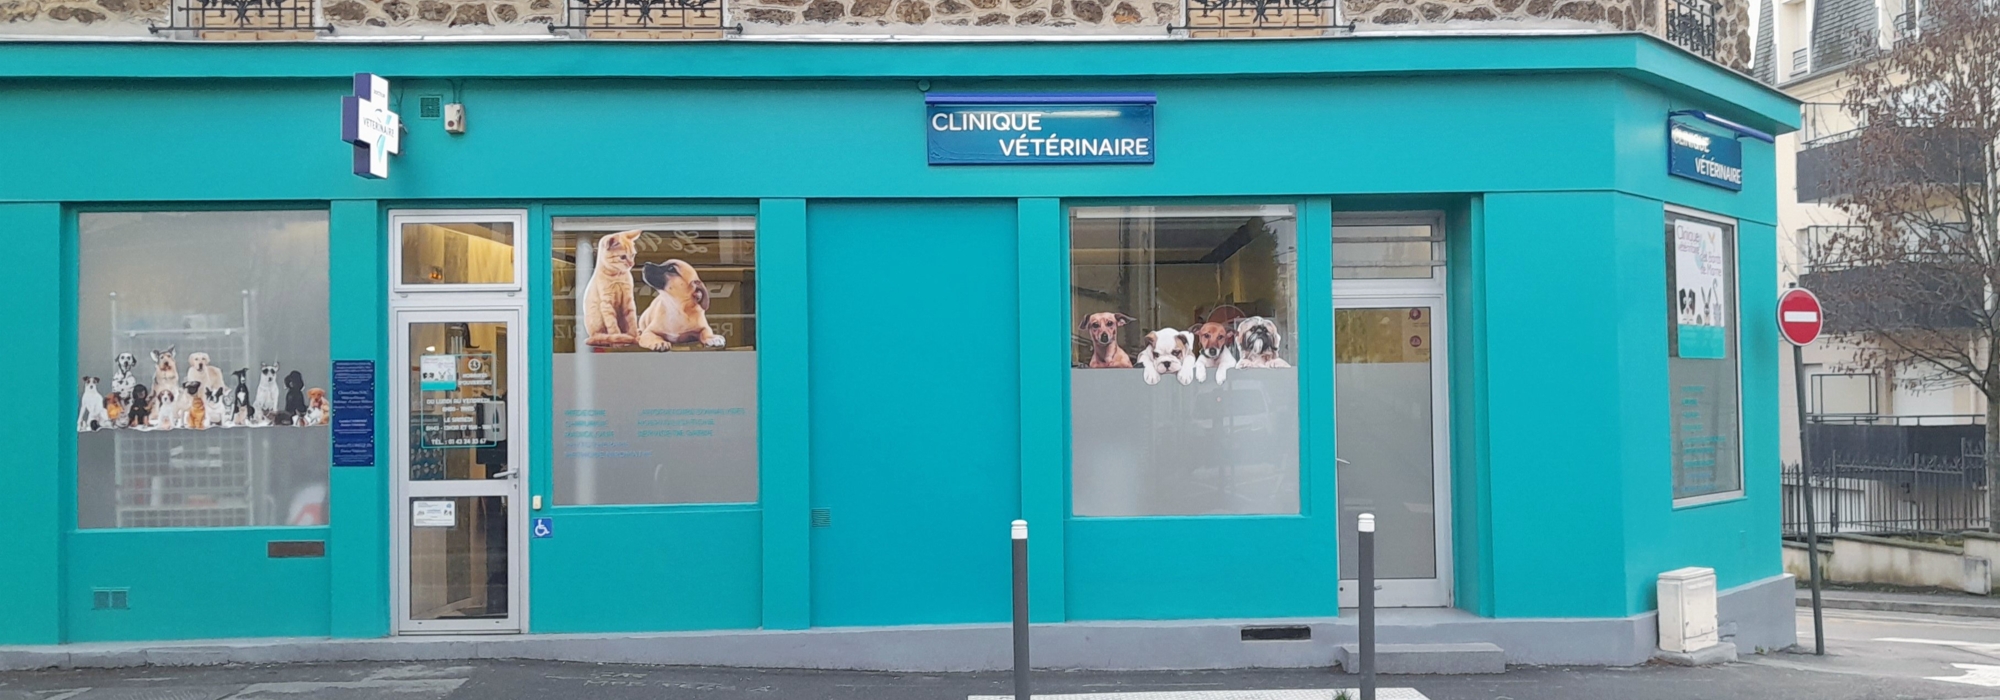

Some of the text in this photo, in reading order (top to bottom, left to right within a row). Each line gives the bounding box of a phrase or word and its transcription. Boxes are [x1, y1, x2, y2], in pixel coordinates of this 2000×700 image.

[931, 112, 1042, 131] CLINIQUE
[999, 133, 1149, 157] VÉTÉRINAIRE
[1695, 154, 1742, 185] VÉTÉRINAIRE
